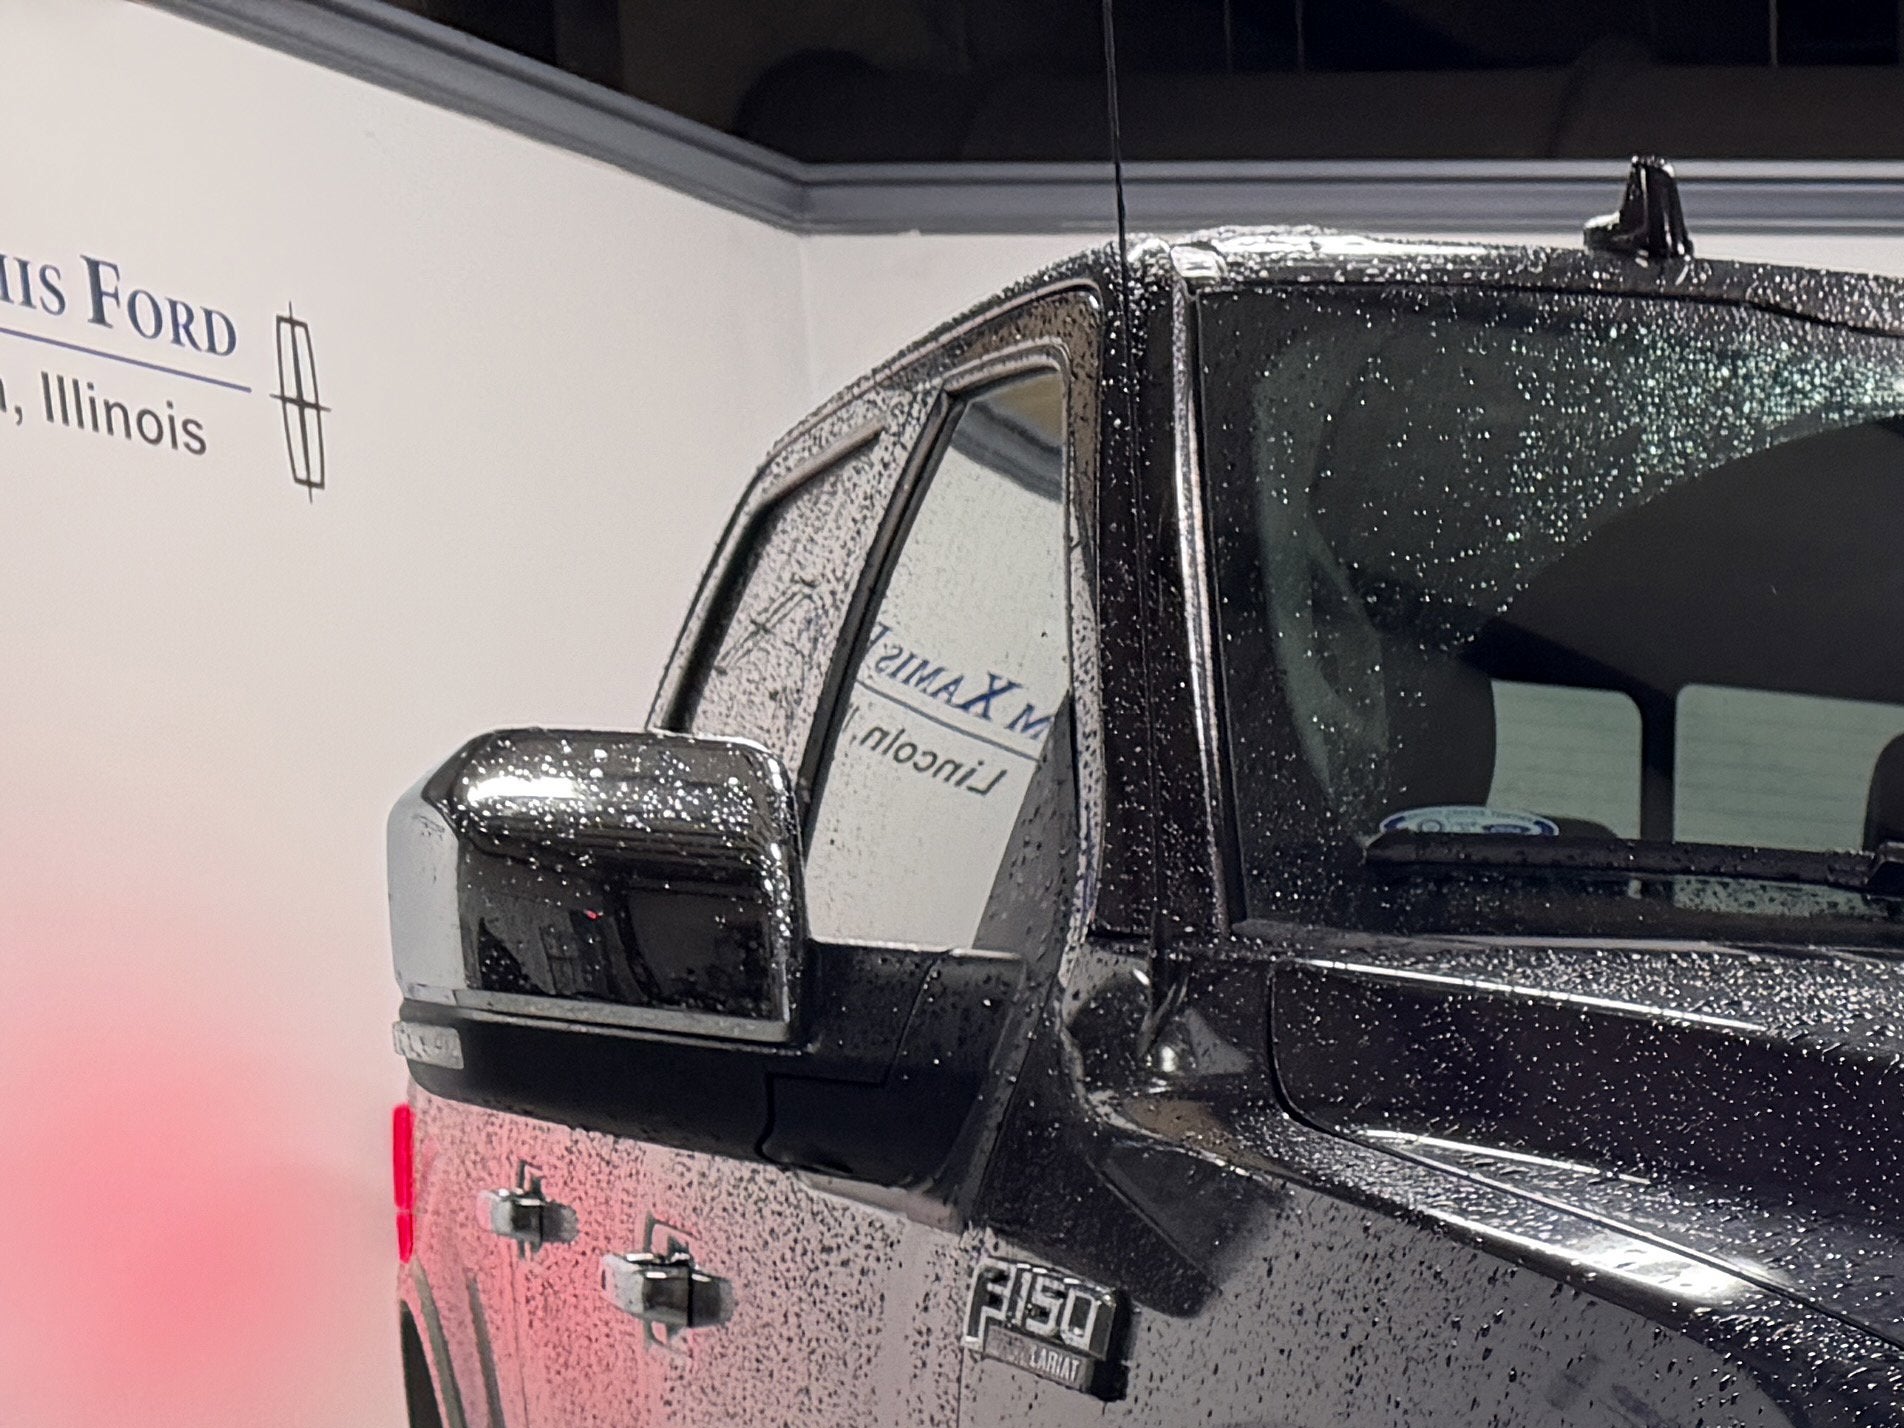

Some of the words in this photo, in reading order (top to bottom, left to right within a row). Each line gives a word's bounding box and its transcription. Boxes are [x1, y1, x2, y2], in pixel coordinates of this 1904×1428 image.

[80, 254, 237, 357] FORD
[41, 370, 207, 456] Illinois
[1029, 1343, 1080, 1382] LARIAT
